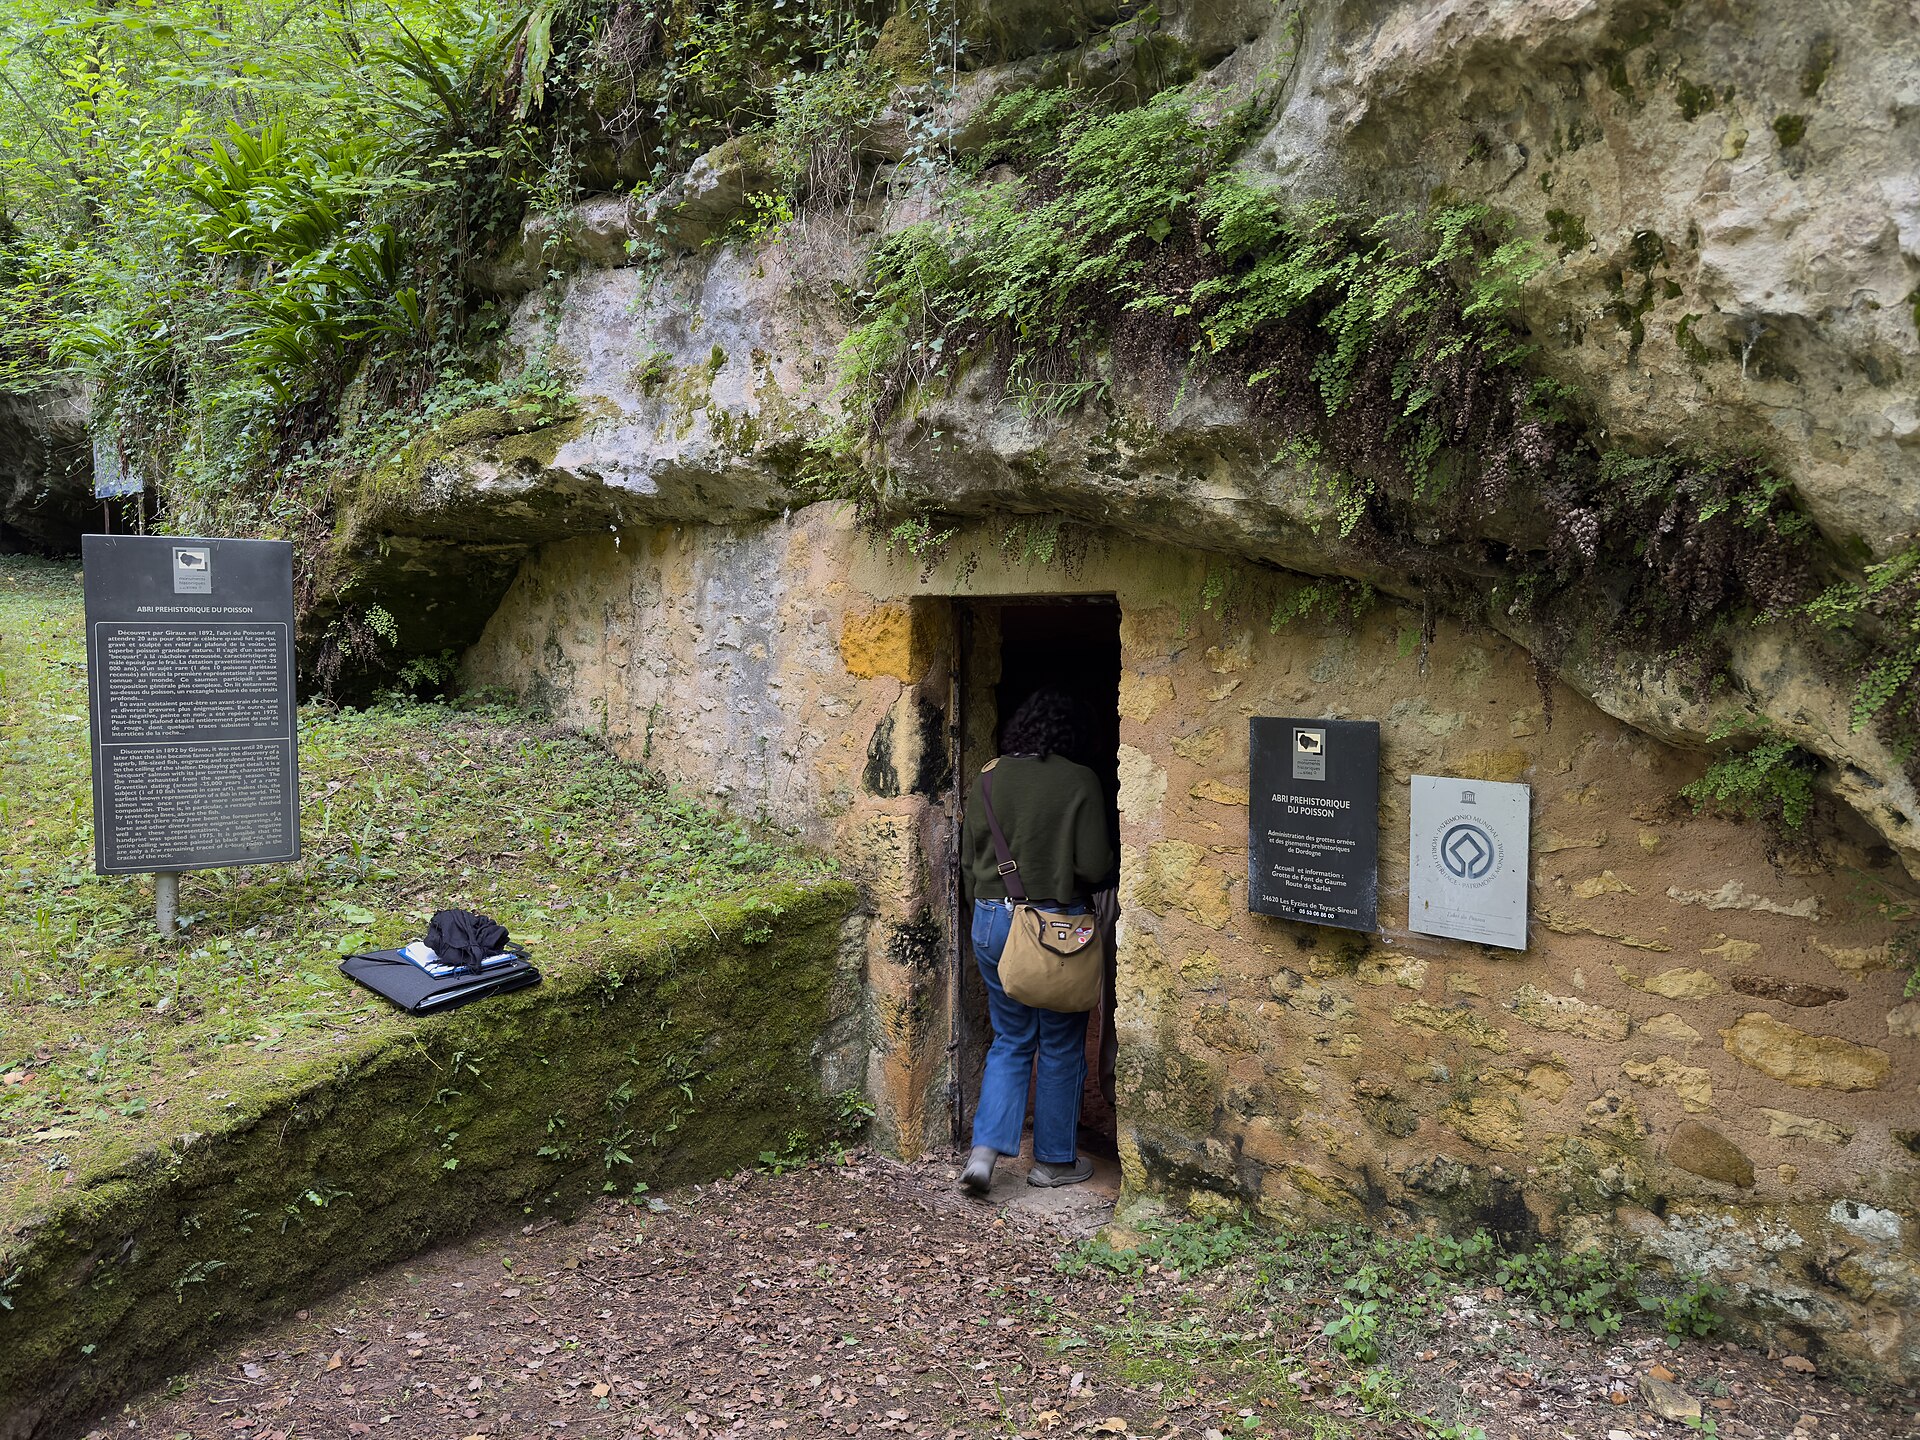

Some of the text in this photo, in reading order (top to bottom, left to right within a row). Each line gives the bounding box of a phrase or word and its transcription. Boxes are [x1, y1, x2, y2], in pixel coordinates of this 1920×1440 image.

[155, 606, 210, 614] PREHISTORIQUE
[240, 767, 280, 775] characterizing
[1272, 794, 1350, 809] ABRI PREHISTORIQUE
[1288, 806, 1334, 817] DU POISSON
[1437, 814, 1498, 838] PATRIMONIO MUNDIAL
[1268, 830, 1305, 840] Administration
[1285, 840, 1310, 848] gisements
[1296, 848, 1321, 857] Dordogne
[1274, 864, 1295, 872] Accueil
[1305, 868, 1340, 879] information
[1462, 843, 1504, 889] PATRIMOINE MONDIAL
[1272, 871, 1290, 879] Grotte
[1324, 878, 1347, 886] Gaume
[1285, 880, 1302, 889] Route
[1313, 884, 1331, 892] Sarlat
[1290, 900, 1308, 908] Eyzies
[1318, 904, 1357, 915] Tayac-Sireuil
